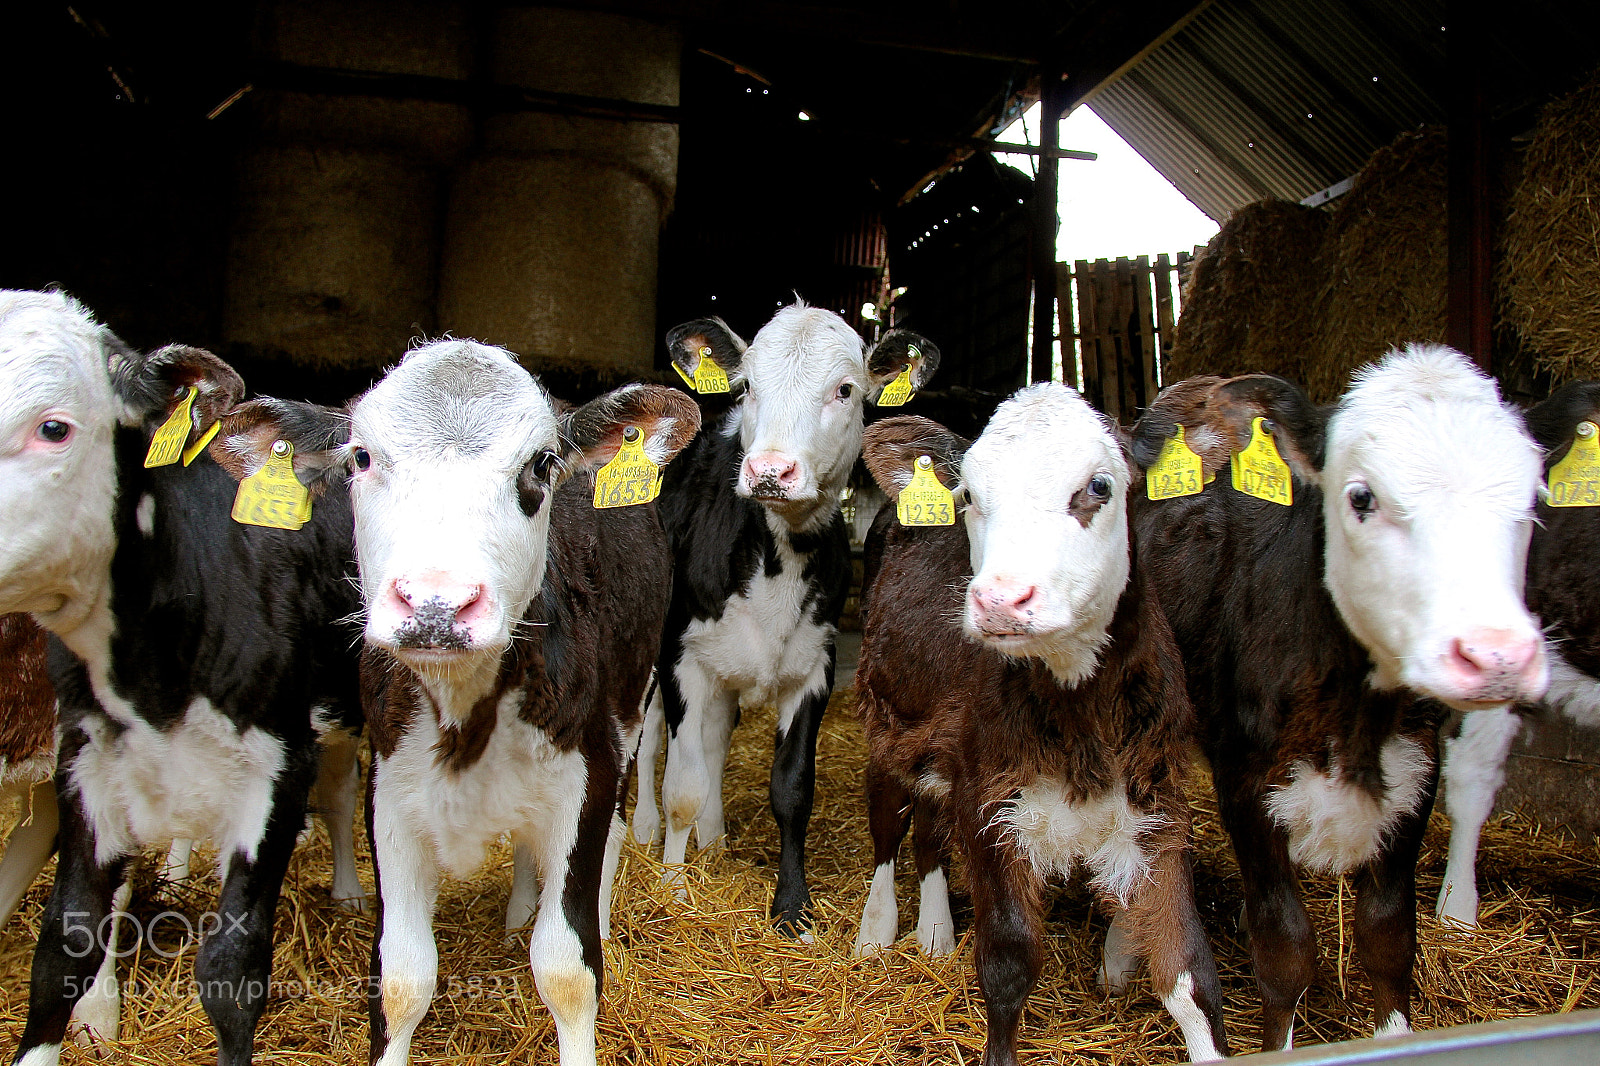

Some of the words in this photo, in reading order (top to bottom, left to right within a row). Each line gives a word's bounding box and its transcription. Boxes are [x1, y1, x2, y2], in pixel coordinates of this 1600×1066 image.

[697, 378, 727, 393] 2085
[878, 392, 907, 405] 2085
[600, 479, 651, 507] 1653
[1152, 469, 1199, 498] 1233
[905, 503, 950, 525] 1233
